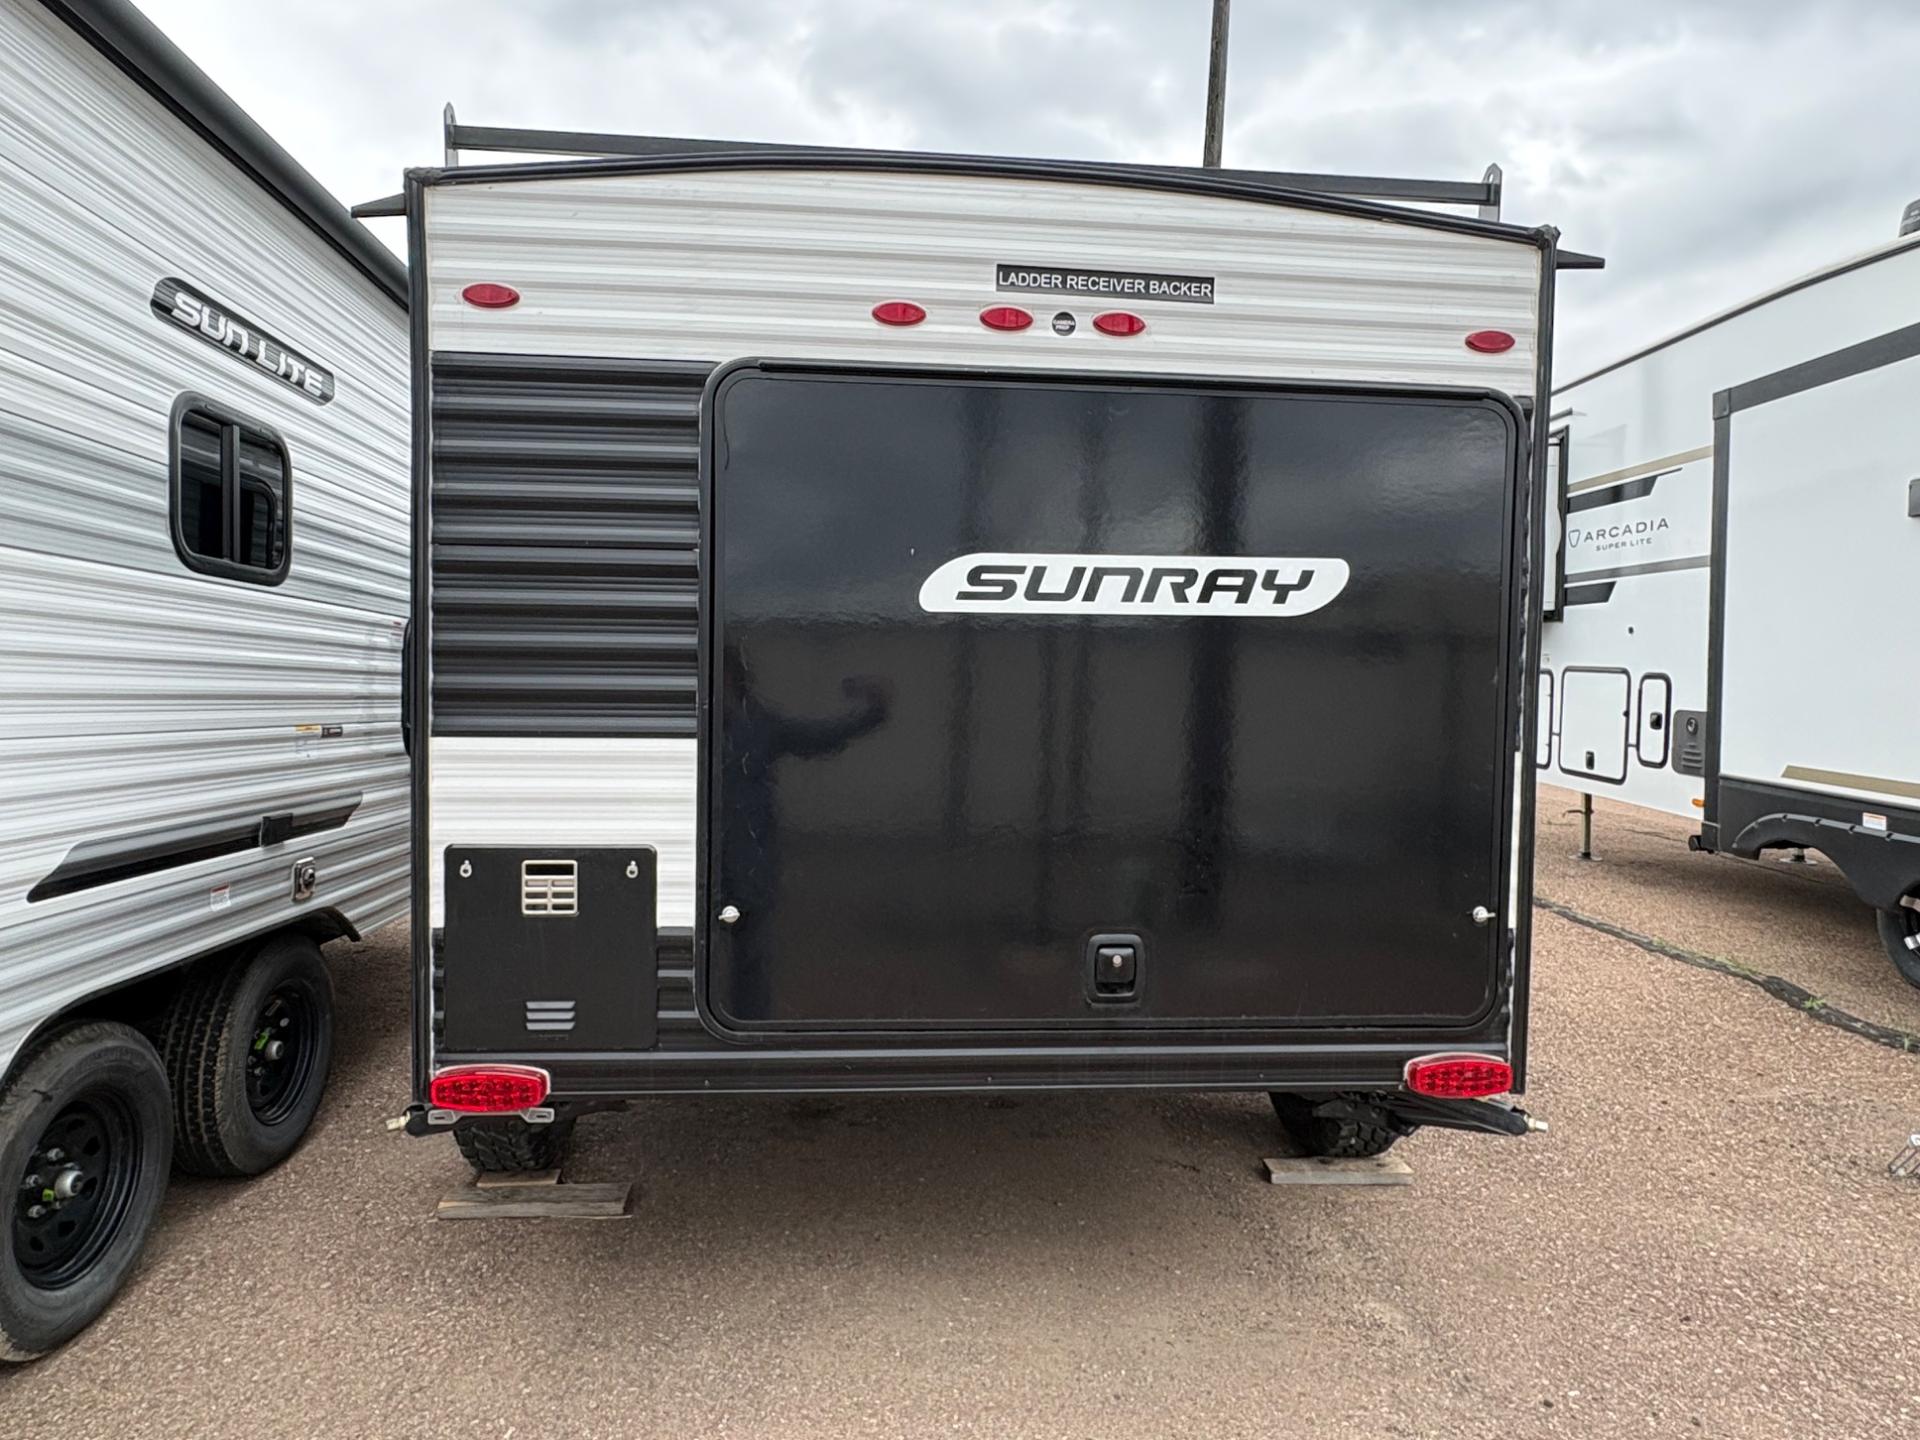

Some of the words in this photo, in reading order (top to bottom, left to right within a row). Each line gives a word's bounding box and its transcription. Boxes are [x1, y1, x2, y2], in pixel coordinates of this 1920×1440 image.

[999, 271, 1062, 289] LADDER
[1066, 275, 1147, 294] RECEIVER
[1149, 281, 1212, 298] BACKER
[171, 292, 250, 356] SUN
[255, 340, 323, 397] LITE
[1583, 518, 1669, 542] ARCADIA
[1596, 541, 1627, 551] SUPER
[1630, 538, 1653, 547] LITE
[955, 565, 1316, 605] SUNRAY
